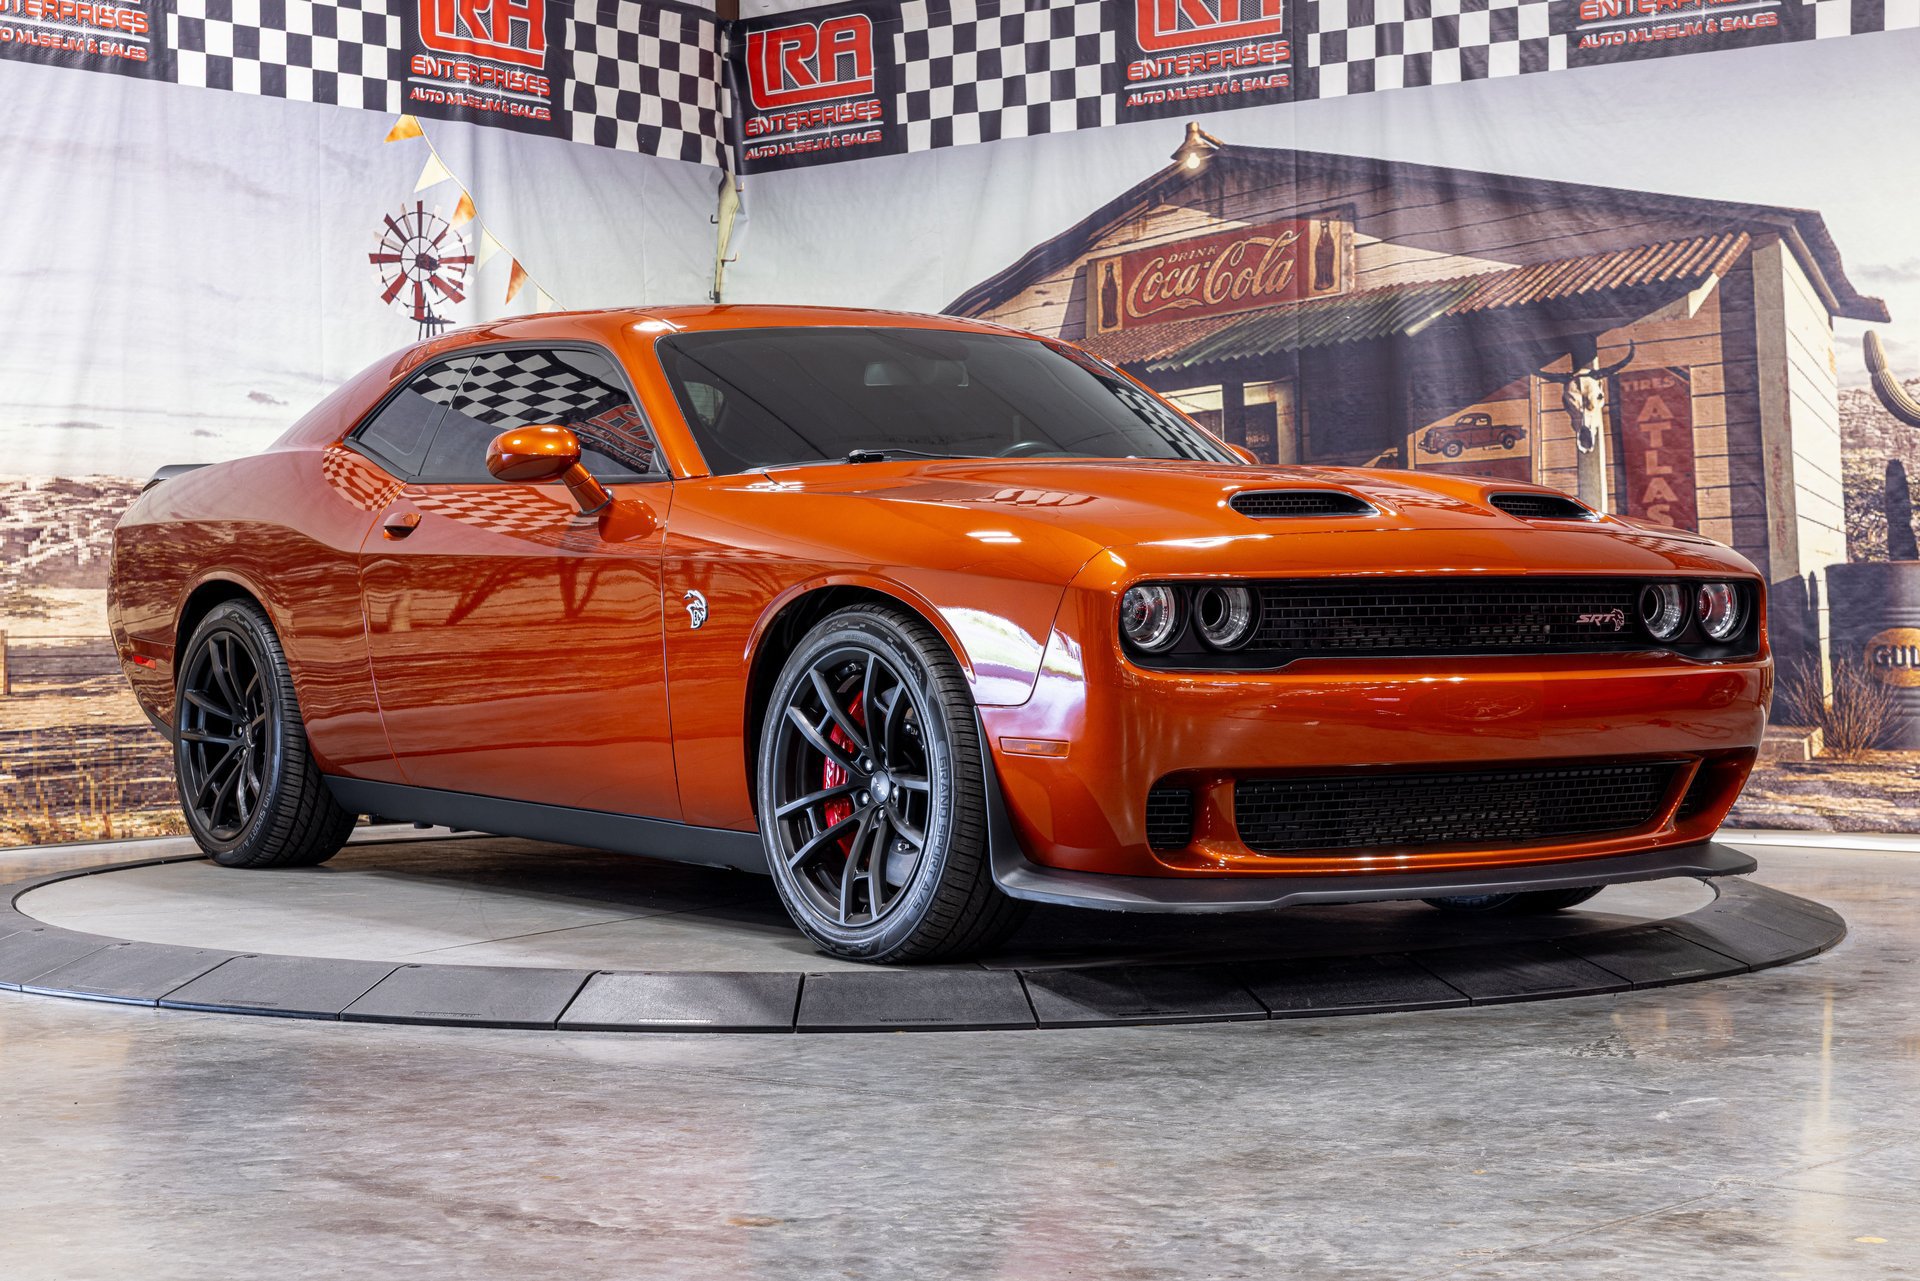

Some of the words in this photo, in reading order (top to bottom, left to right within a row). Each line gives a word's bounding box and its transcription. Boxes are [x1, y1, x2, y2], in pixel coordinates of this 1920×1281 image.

[16, 29, 84, 52] MUSEUM
[87, 38, 98, 54] &
[100, 41, 148, 62] SALES
[1579, 31, 1627, 49] AUTO
[1628, 21, 1702, 43] MUSEUM
[1706, 18, 1718, 34] &
[1720, 11, 1778, 32] SALES
[410, 54, 550, 97] ENTERPRISES
[1127, 40, 1290, 81] ENTERPRISES
[409, 87, 445, 103] AUTO
[446, 91, 501, 112] MUSEUM
[501, 101, 509, 114] &
[510, 103, 551, 121] SALES
[1126, 91, 1165, 107] AUTO
[1166, 82, 1229, 101] MUSEUM
[1230, 79, 1241, 93] &
[1242, 74, 1289, 92] SALES
[745, 99, 882, 136] ENTERPRISES
[745, 145, 778, 160] AUTO
[779, 136, 831, 155] MUSEUM
[832, 135, 841, 147] &
[842, 130, 882, 146] SALES
[1168, 245, 1218, 263] DRINK
[1126, 229, 1305, 319] Coca-Cola
[1621, 376, 1676, 392] TIRES
[1636, 394, 1679, 526] ATLAS
[1576, 613, 1616, 626] SRT
[939, 756, 949, 818] GRAND
[930, 823, 948, 879] SPORT
